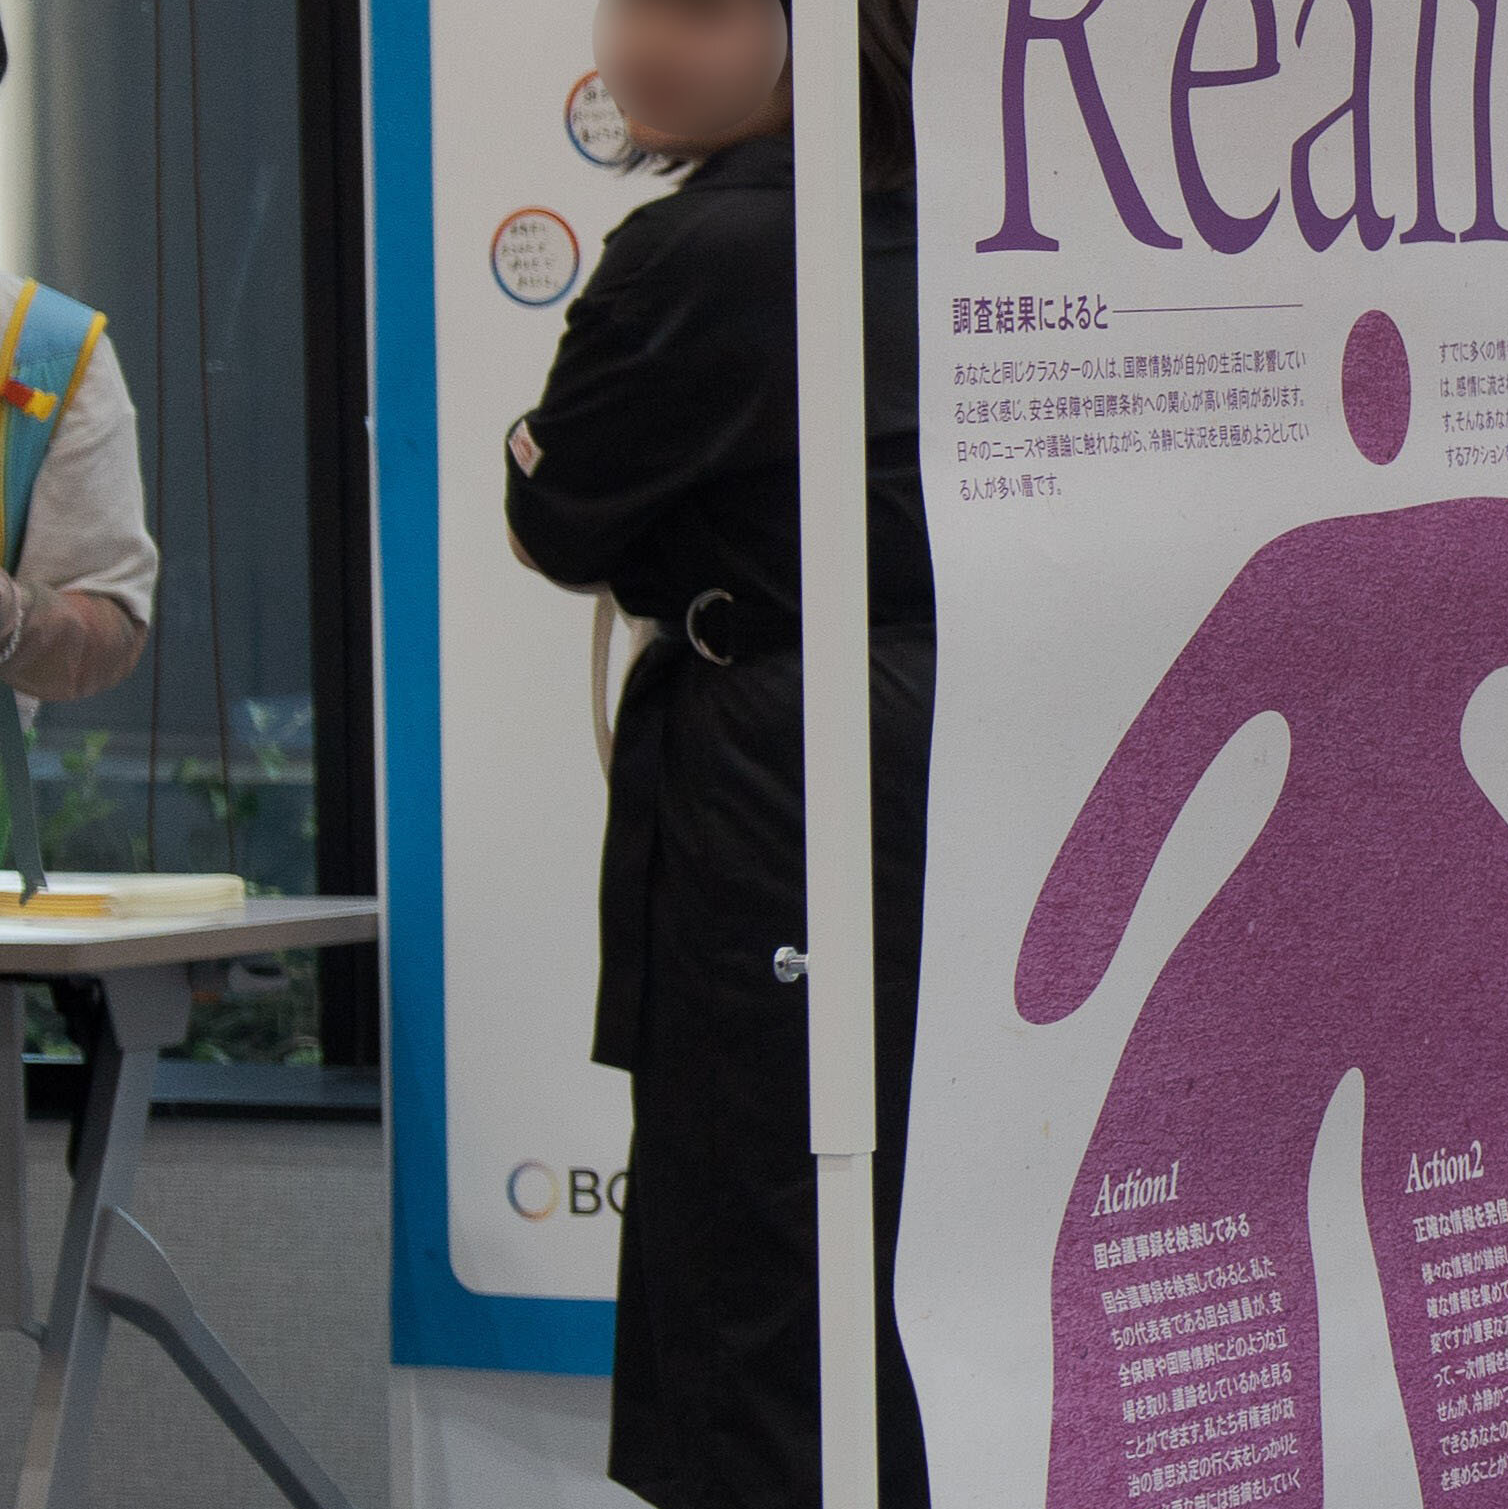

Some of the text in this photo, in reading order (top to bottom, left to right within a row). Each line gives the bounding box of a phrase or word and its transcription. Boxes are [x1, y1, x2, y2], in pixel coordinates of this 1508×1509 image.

[952, 293, 1109, 336] 調査結果によると
[954, 348, 1307, 388] あなたと同じクラスターの人は、国際情勢が自分の生活に影響してい
[954, 384, 1306, 426] ると強く感じ、安全保障や国際条約への関心が高い傾向があります。
[956, 422, 1310, 464] 日々のニュースや議論に触れながら、冷静に状況を見極めようとしてい
[958, 470, 1065, 502] る人が多い層です。
[1091, 1161, 1181, 1218] Action1
[1404, 1140, 1485, 1194] Action2
[1093, 1213, 1251, 1271] 国会議事録を検索してみる
[1102, 1258, 1277, 1316] 国会議事録を検索してみると、私た
[1110, 1291, 1285, 1351] ちの代表者である国会議員が、安
[1117, 1328, 1289, 1387] 全保障や国際情勢にどのような立
[1121, 1363, 1293, 1424] 場を取り、議論をしているかを見る
[1124, 1397, 1296, 1460] ことができます。私たち有権者が政
[1127, 1432, 1299, 1498] 治の意思決定の行く末をしっかりと
